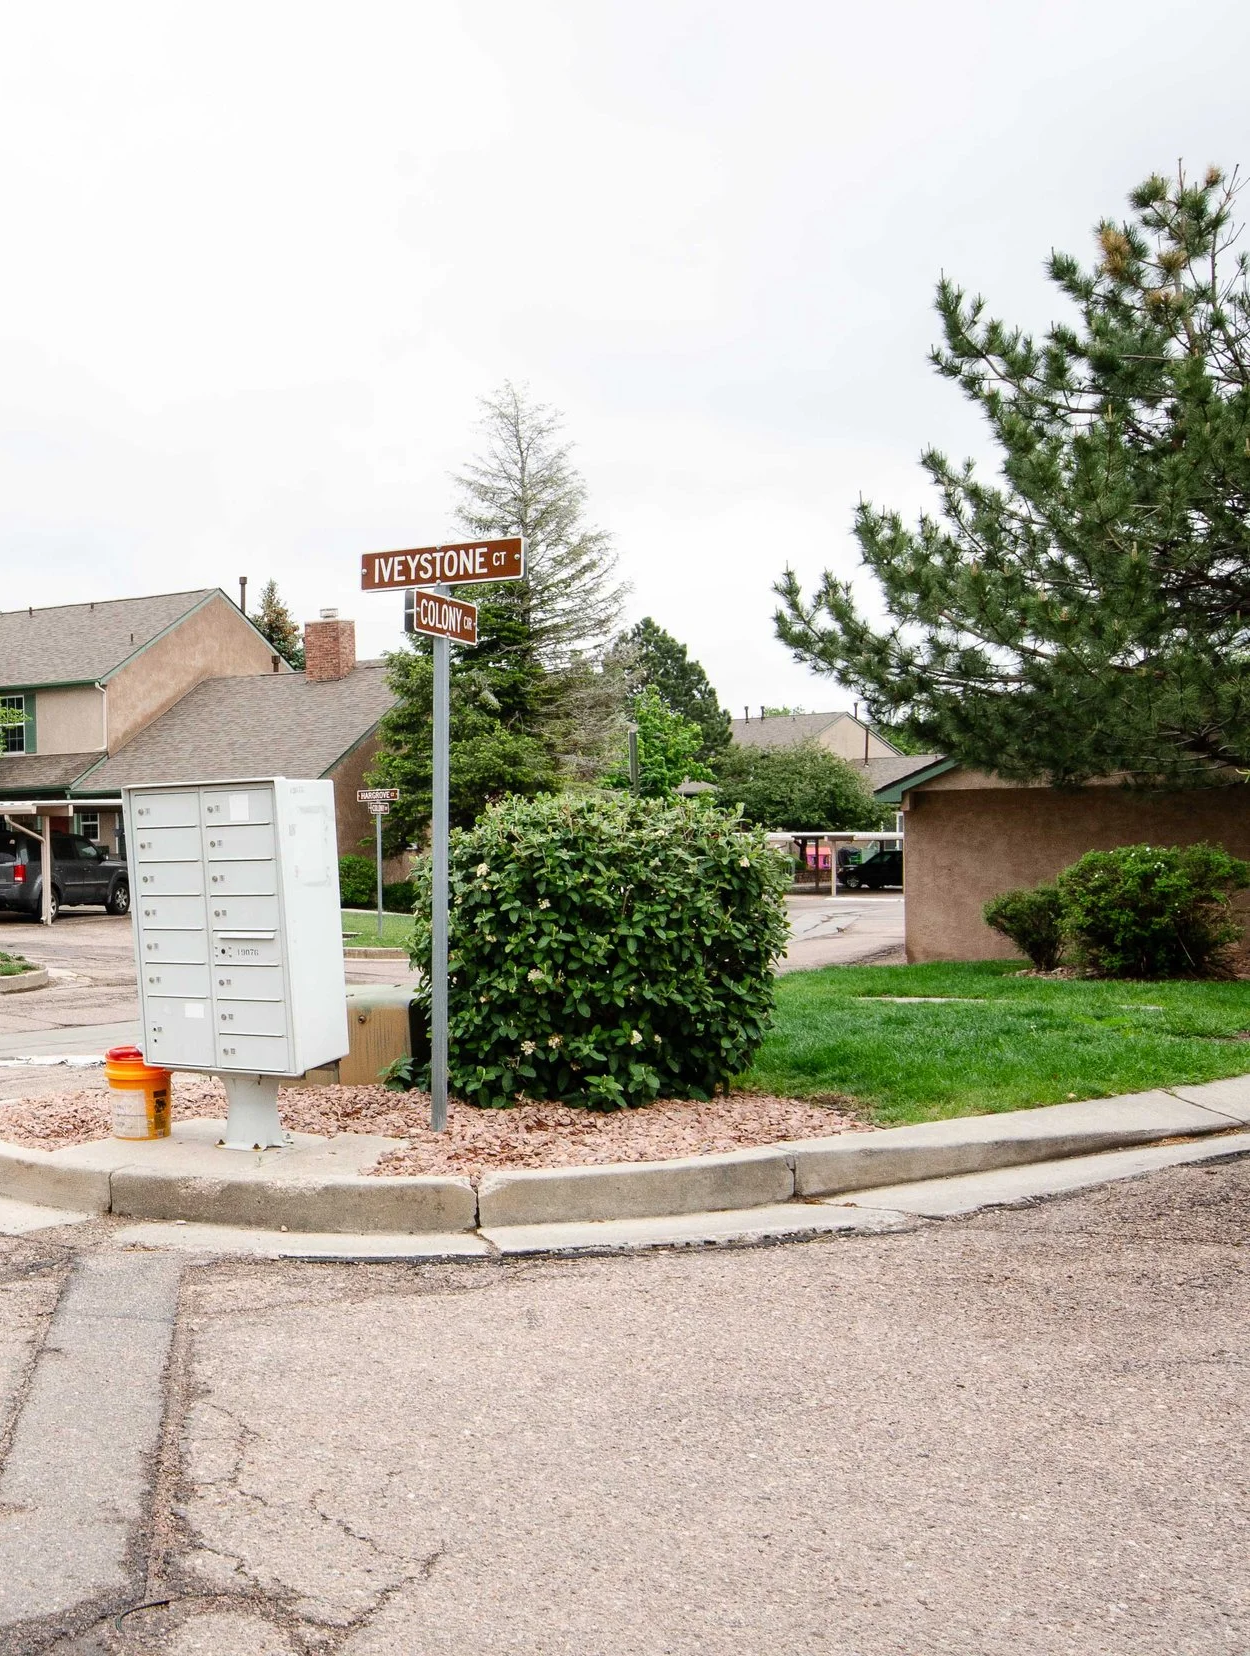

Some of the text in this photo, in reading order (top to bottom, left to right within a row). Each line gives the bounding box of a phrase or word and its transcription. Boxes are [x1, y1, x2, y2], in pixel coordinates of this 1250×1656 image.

[374, 548, 507, 583] IVEYSTONE CT
[420, 598, 462, 633] COLONY
